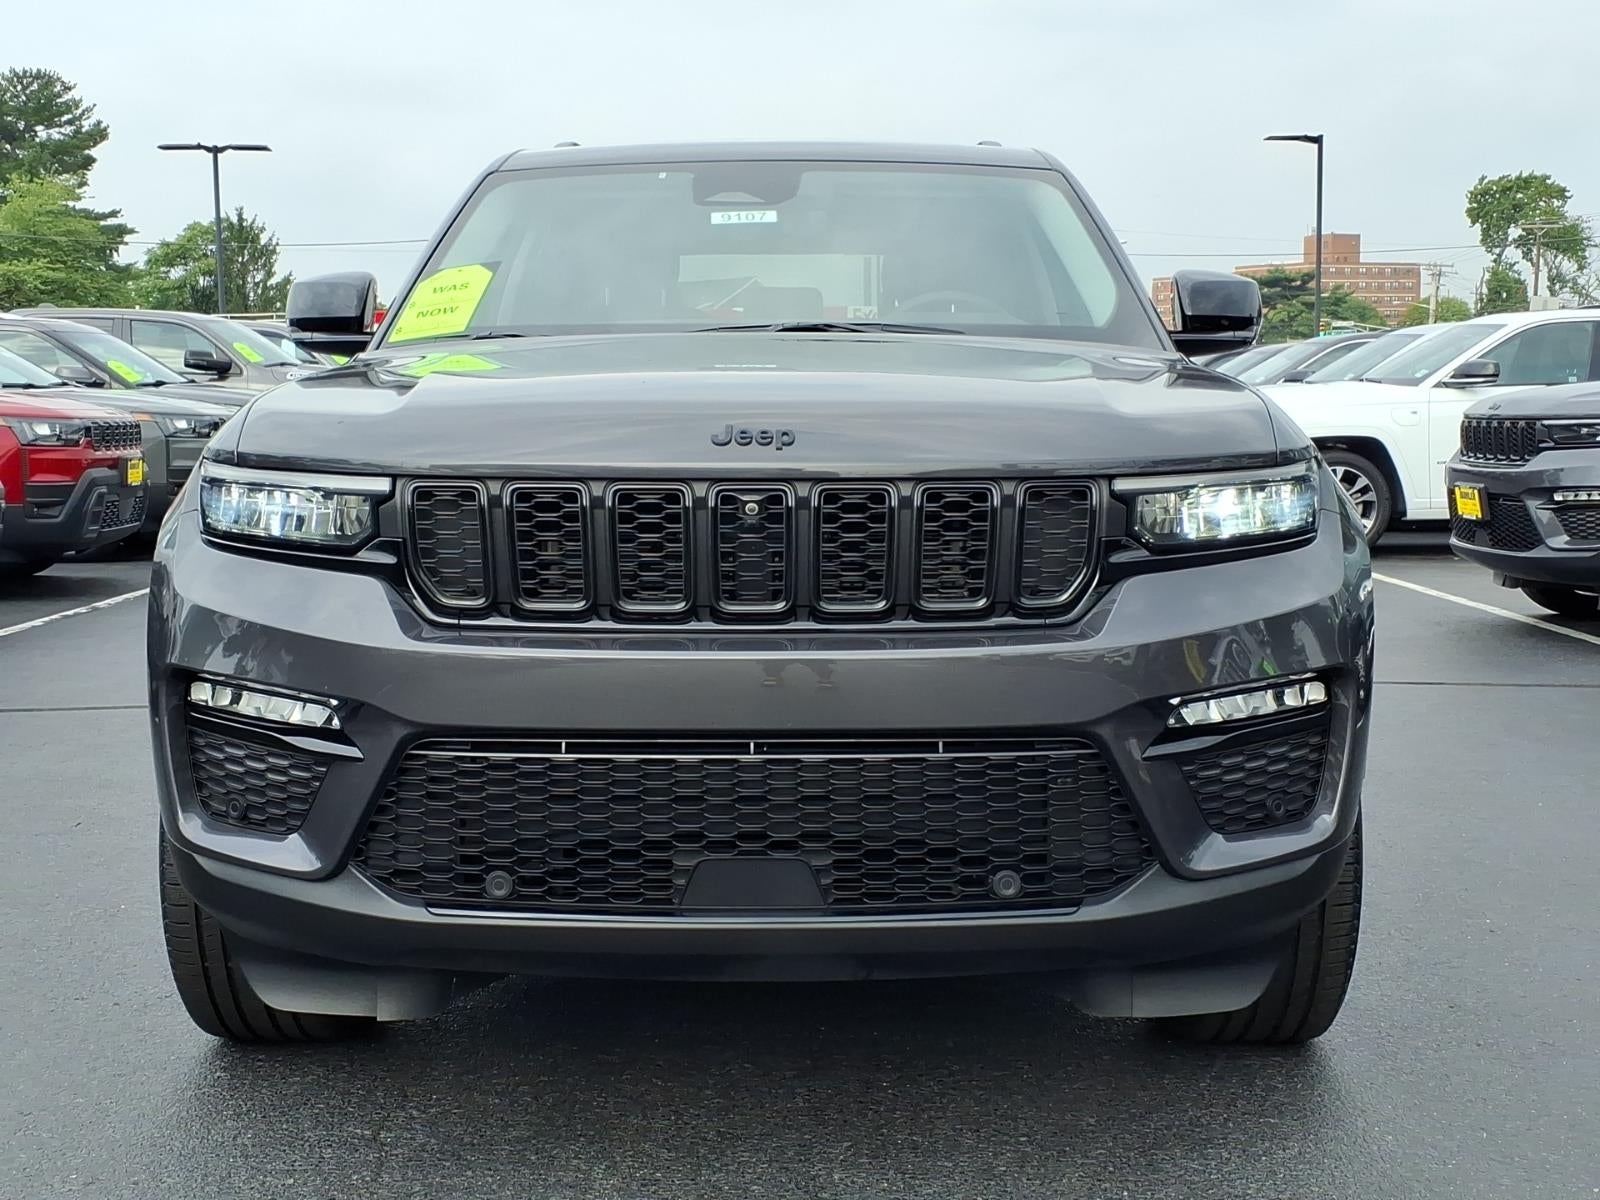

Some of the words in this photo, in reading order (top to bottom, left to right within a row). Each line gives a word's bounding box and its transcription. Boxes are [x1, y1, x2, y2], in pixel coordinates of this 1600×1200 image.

[720, 211, 767, 222] 9107
[432, 282, 470, 294] WAS
[416, 305, 460, 319] NOW
[710, 423, 796, 451] Jeep
